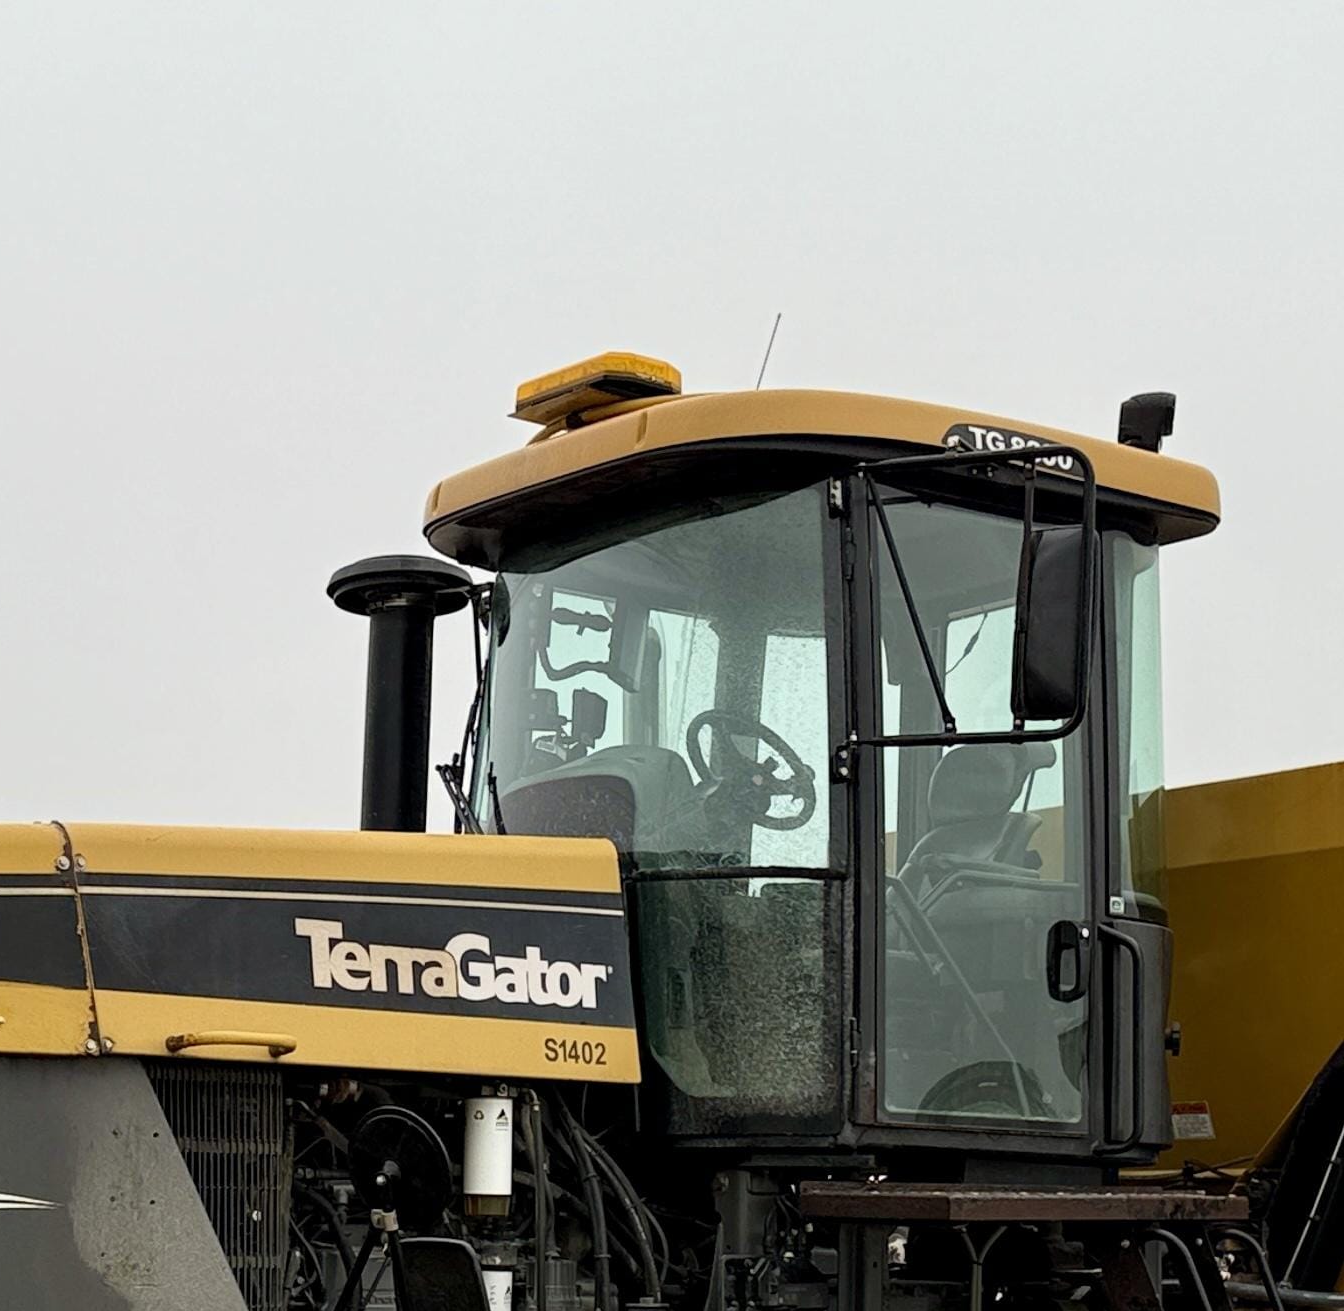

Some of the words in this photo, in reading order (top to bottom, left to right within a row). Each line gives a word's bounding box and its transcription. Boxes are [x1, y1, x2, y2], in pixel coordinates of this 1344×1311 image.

[968, 426, 1006, 451] TG
[294, 918, 610, 1009] TerraGator
[545, 1038, 607, 1065] S1402
